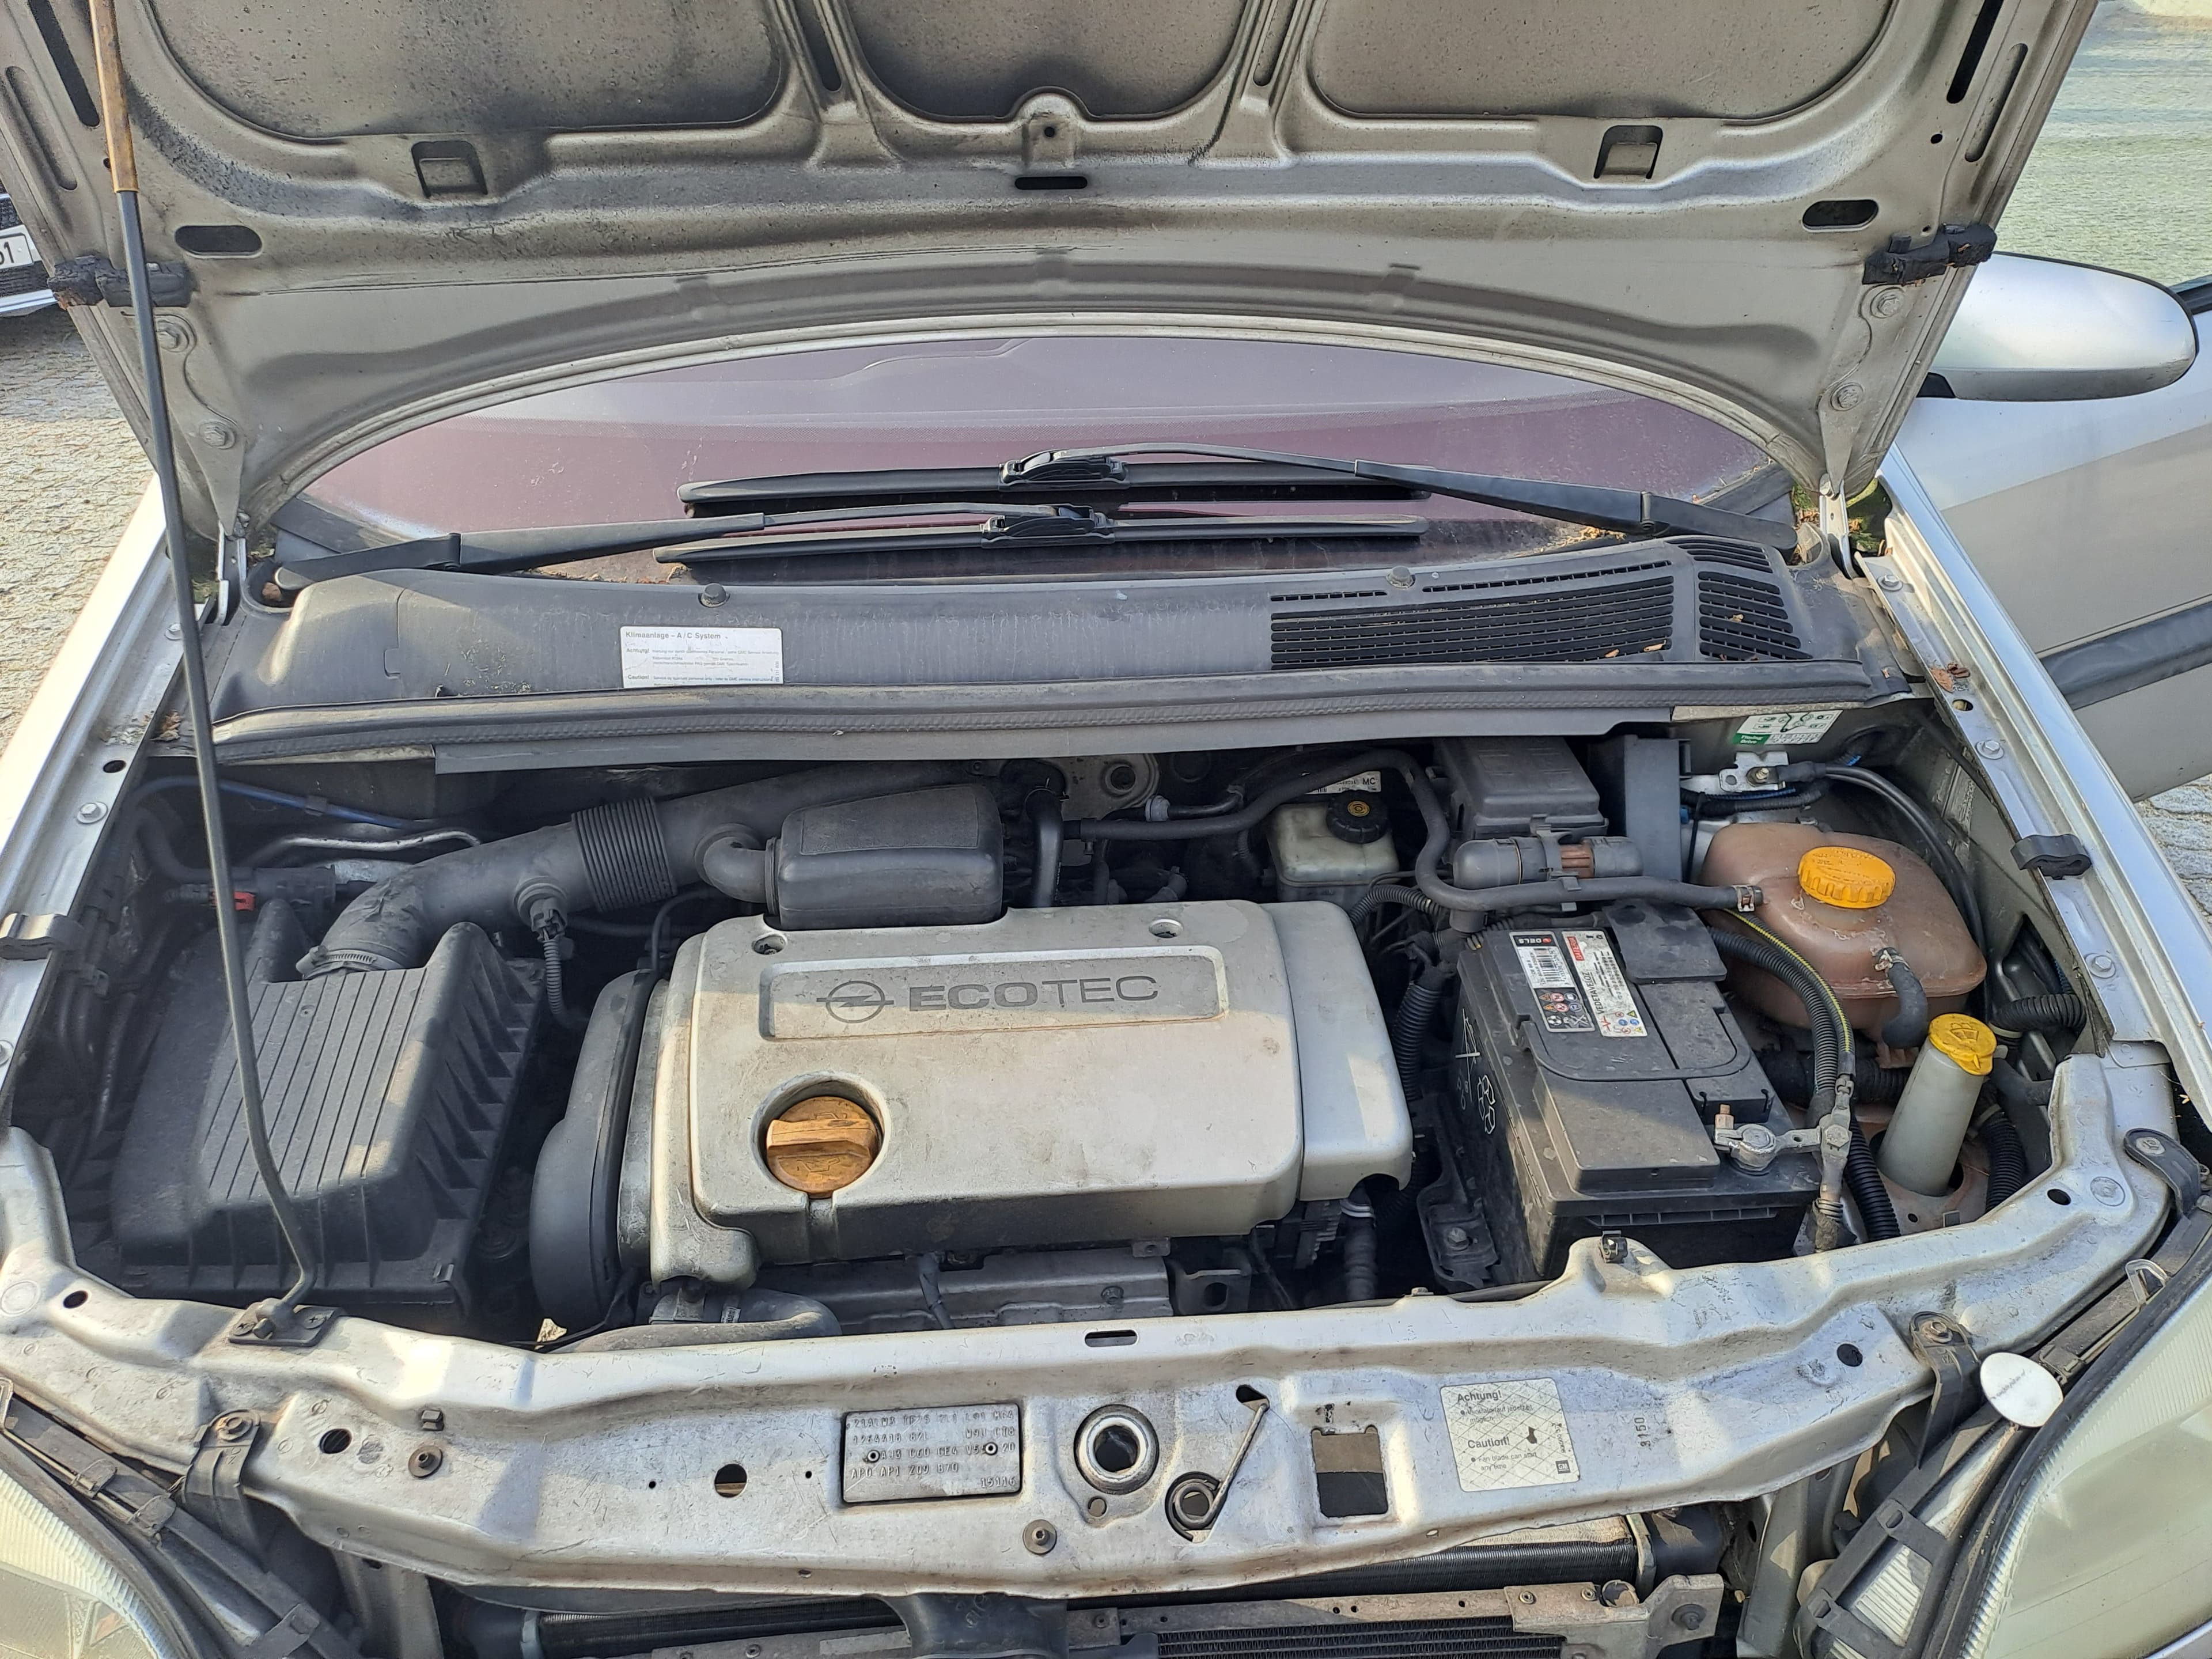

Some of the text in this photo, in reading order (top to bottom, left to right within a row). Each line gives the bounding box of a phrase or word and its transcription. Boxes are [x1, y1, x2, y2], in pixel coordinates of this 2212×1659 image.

[1362, 777, 1376, 785] MC
[908, 975, 1158, 1012] ECOTEC
[1457, 1390, 1502, 1403] Achtung!
[1468, 1436, 1510, 1449] Caution!
[1558, 1463, 1569, 1471] GM
[981, 1476, 1016, 1488] 15116
